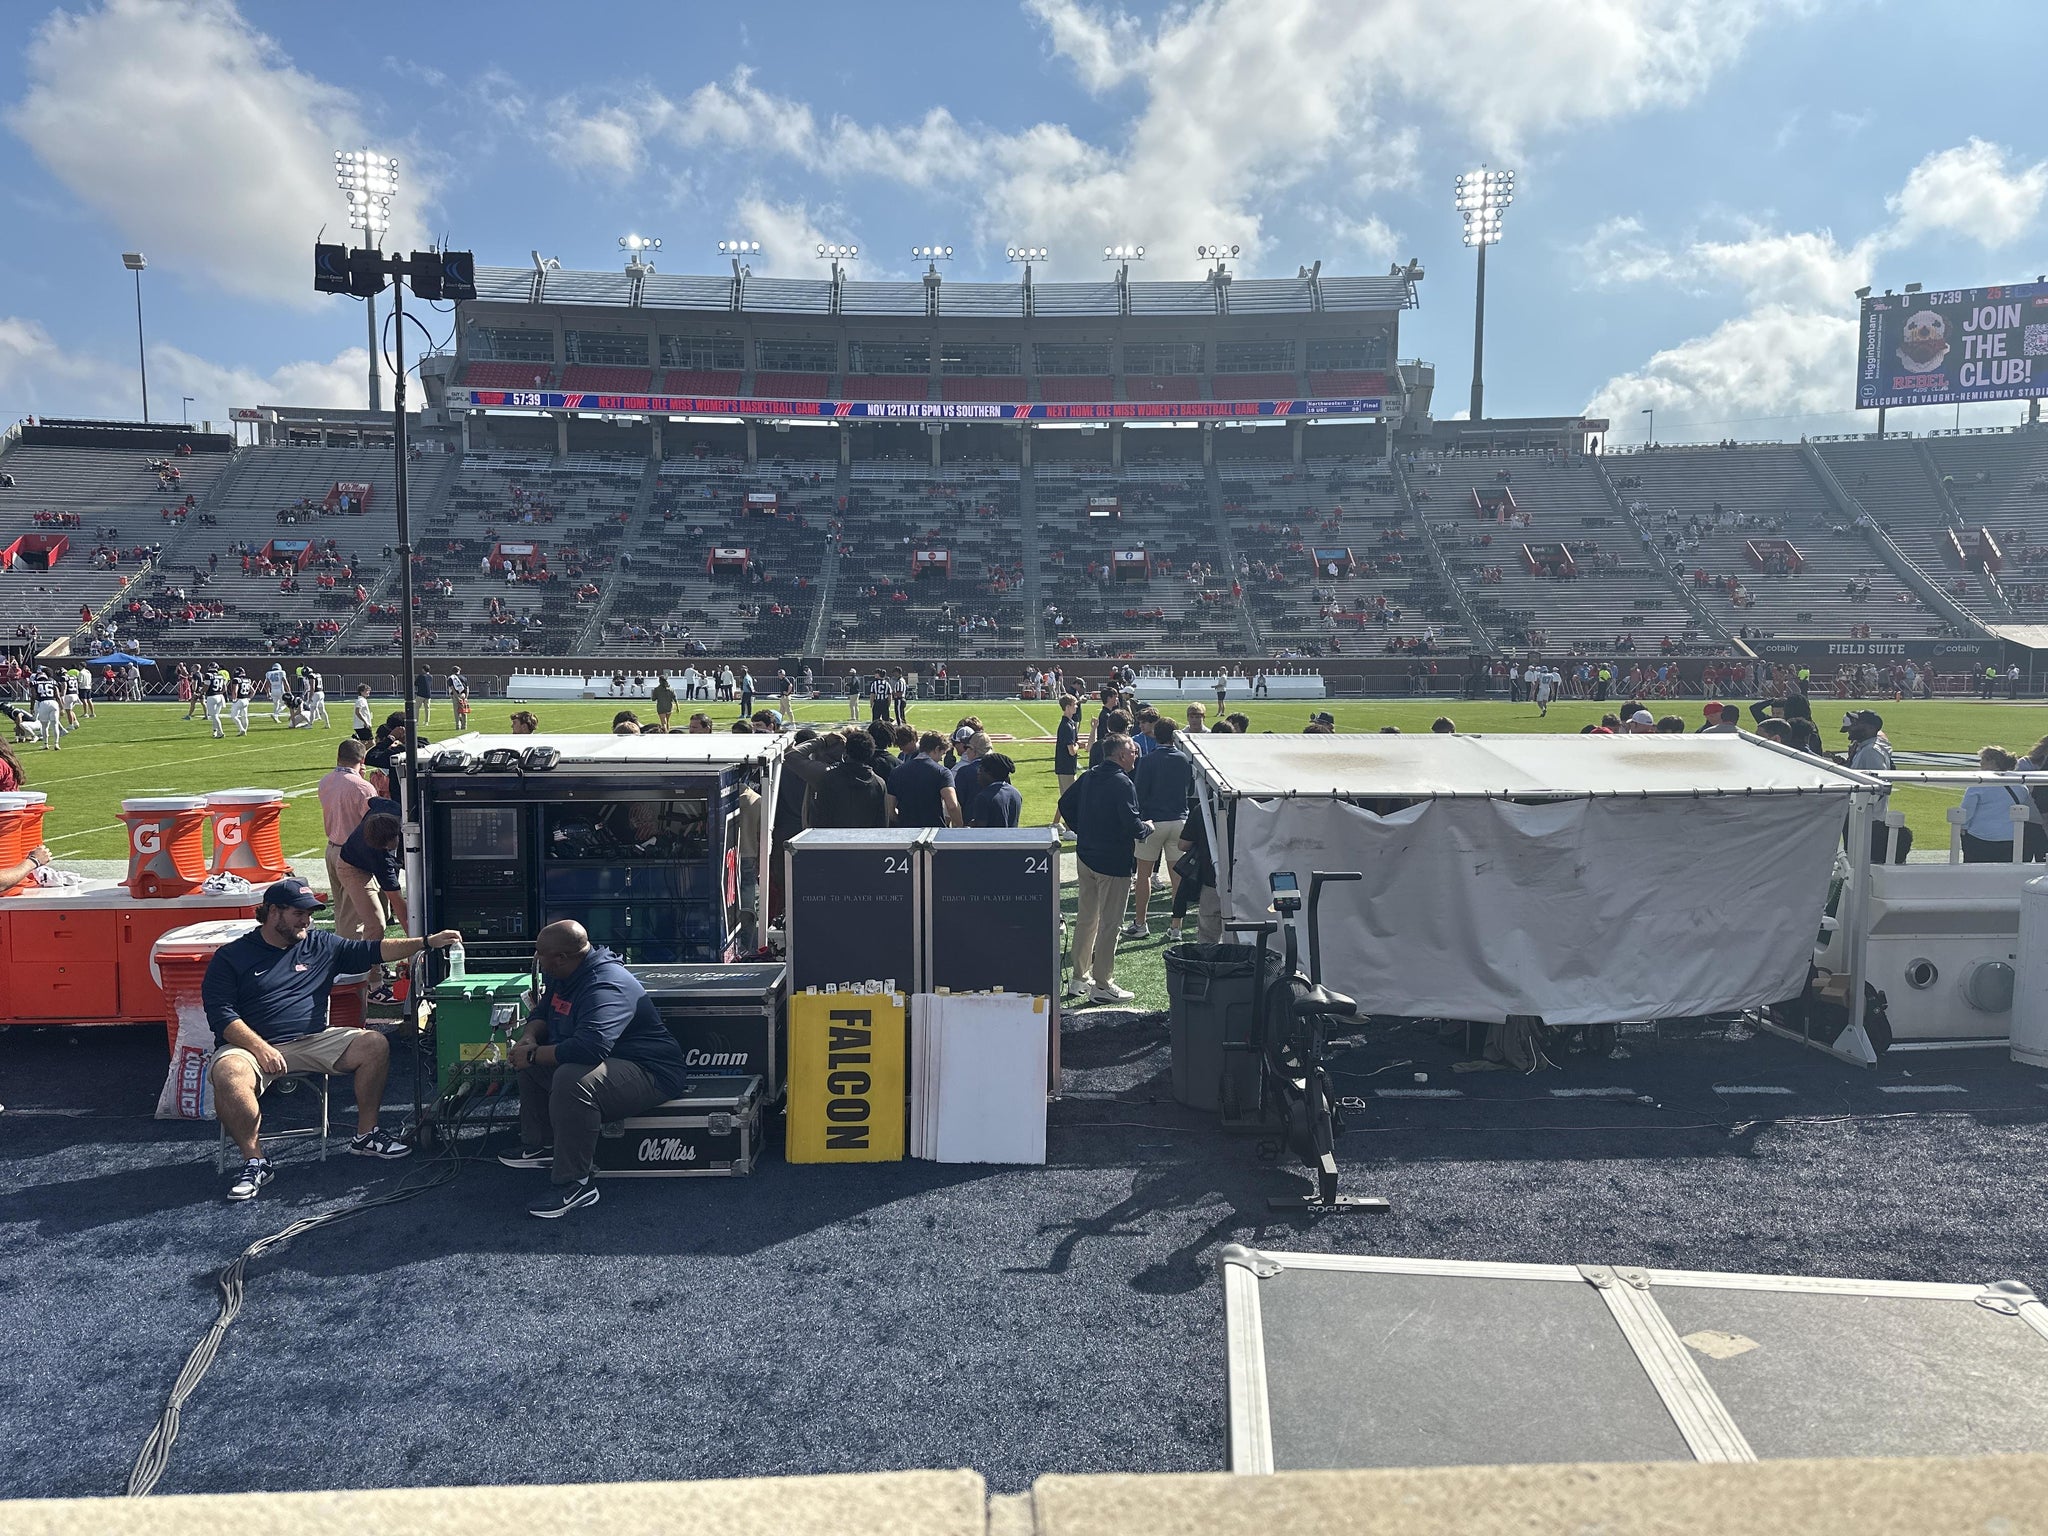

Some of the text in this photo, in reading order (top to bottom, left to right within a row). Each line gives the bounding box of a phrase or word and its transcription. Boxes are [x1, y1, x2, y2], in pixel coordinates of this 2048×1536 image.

[1902, 295, 1909, 307] 0
[1930, 291, 1962, 305] 57:39
[1987, 287, 2002, 299] 25
[1963, 303, 2021, 332] JOIN
[1865, 314, 1876, 380] Higginbotham
[1962, 333, 2006, 359] THE
[1960, 358, 2031, 387] CLUB!
[1893, 374, 1949, 390] REBEL
[513, 393, 540, 405] 57:39
[598, 396, 820, 414] NEXT HOME OLE MISS WOMEN'S BASKETBALL GAME
[1863, 396, 1903, 407] WELCOME
[1907, 395, 1917, 404] TO
[1922, 389, 2014, 403] VAUGHT-HEMINGWAY
[867, 403, 1001, 417] NOV 12TH AT 6PM VS SOUTHERN
[1046, 402, 1259, 417] NEXT HOME OLE MISS WOMEN'S BASKETBALL GAME
[1765, 644, 1799, 653] cotality
[1828, 644, 1905, 654] FIELD SUITE
[1946, 644, 1981, 653] cotality
[878, 684, 885, 694] C
[133, 823, 161, 854] G
[217, 816, 242, 845] G
[884, 856, 909, 874] 24
[1024, 856, 1049, 874] 24
[182, 1052, 200, 1116] CUBE ICE
[825, 1009, 872, 1150] FALCON
[1307, 1195, 1352, 1213] ROGUE
